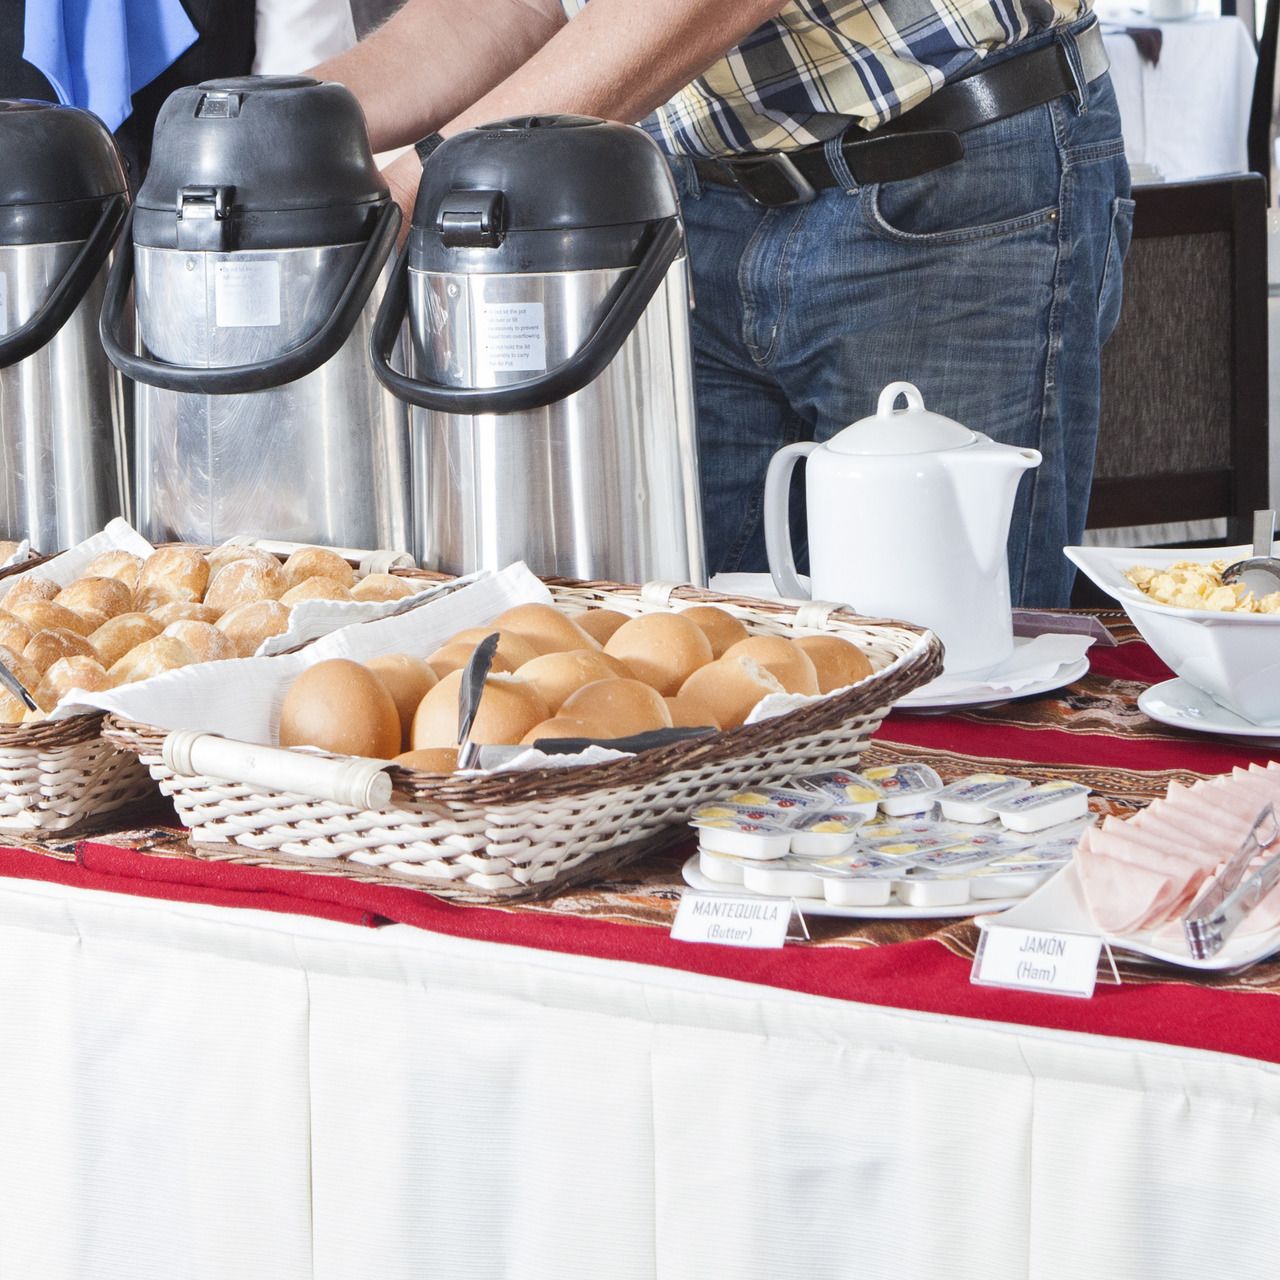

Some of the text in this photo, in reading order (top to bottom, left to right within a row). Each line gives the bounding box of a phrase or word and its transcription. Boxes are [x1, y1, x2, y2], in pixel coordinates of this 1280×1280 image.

[692, 901, 778, 920] MANTEQUILLA
[707, 924, 752, 941] (Butter)
[1020, 935, 1066, 956] JAMÓN
[1017, 960, 1056, 983] (Ham)
